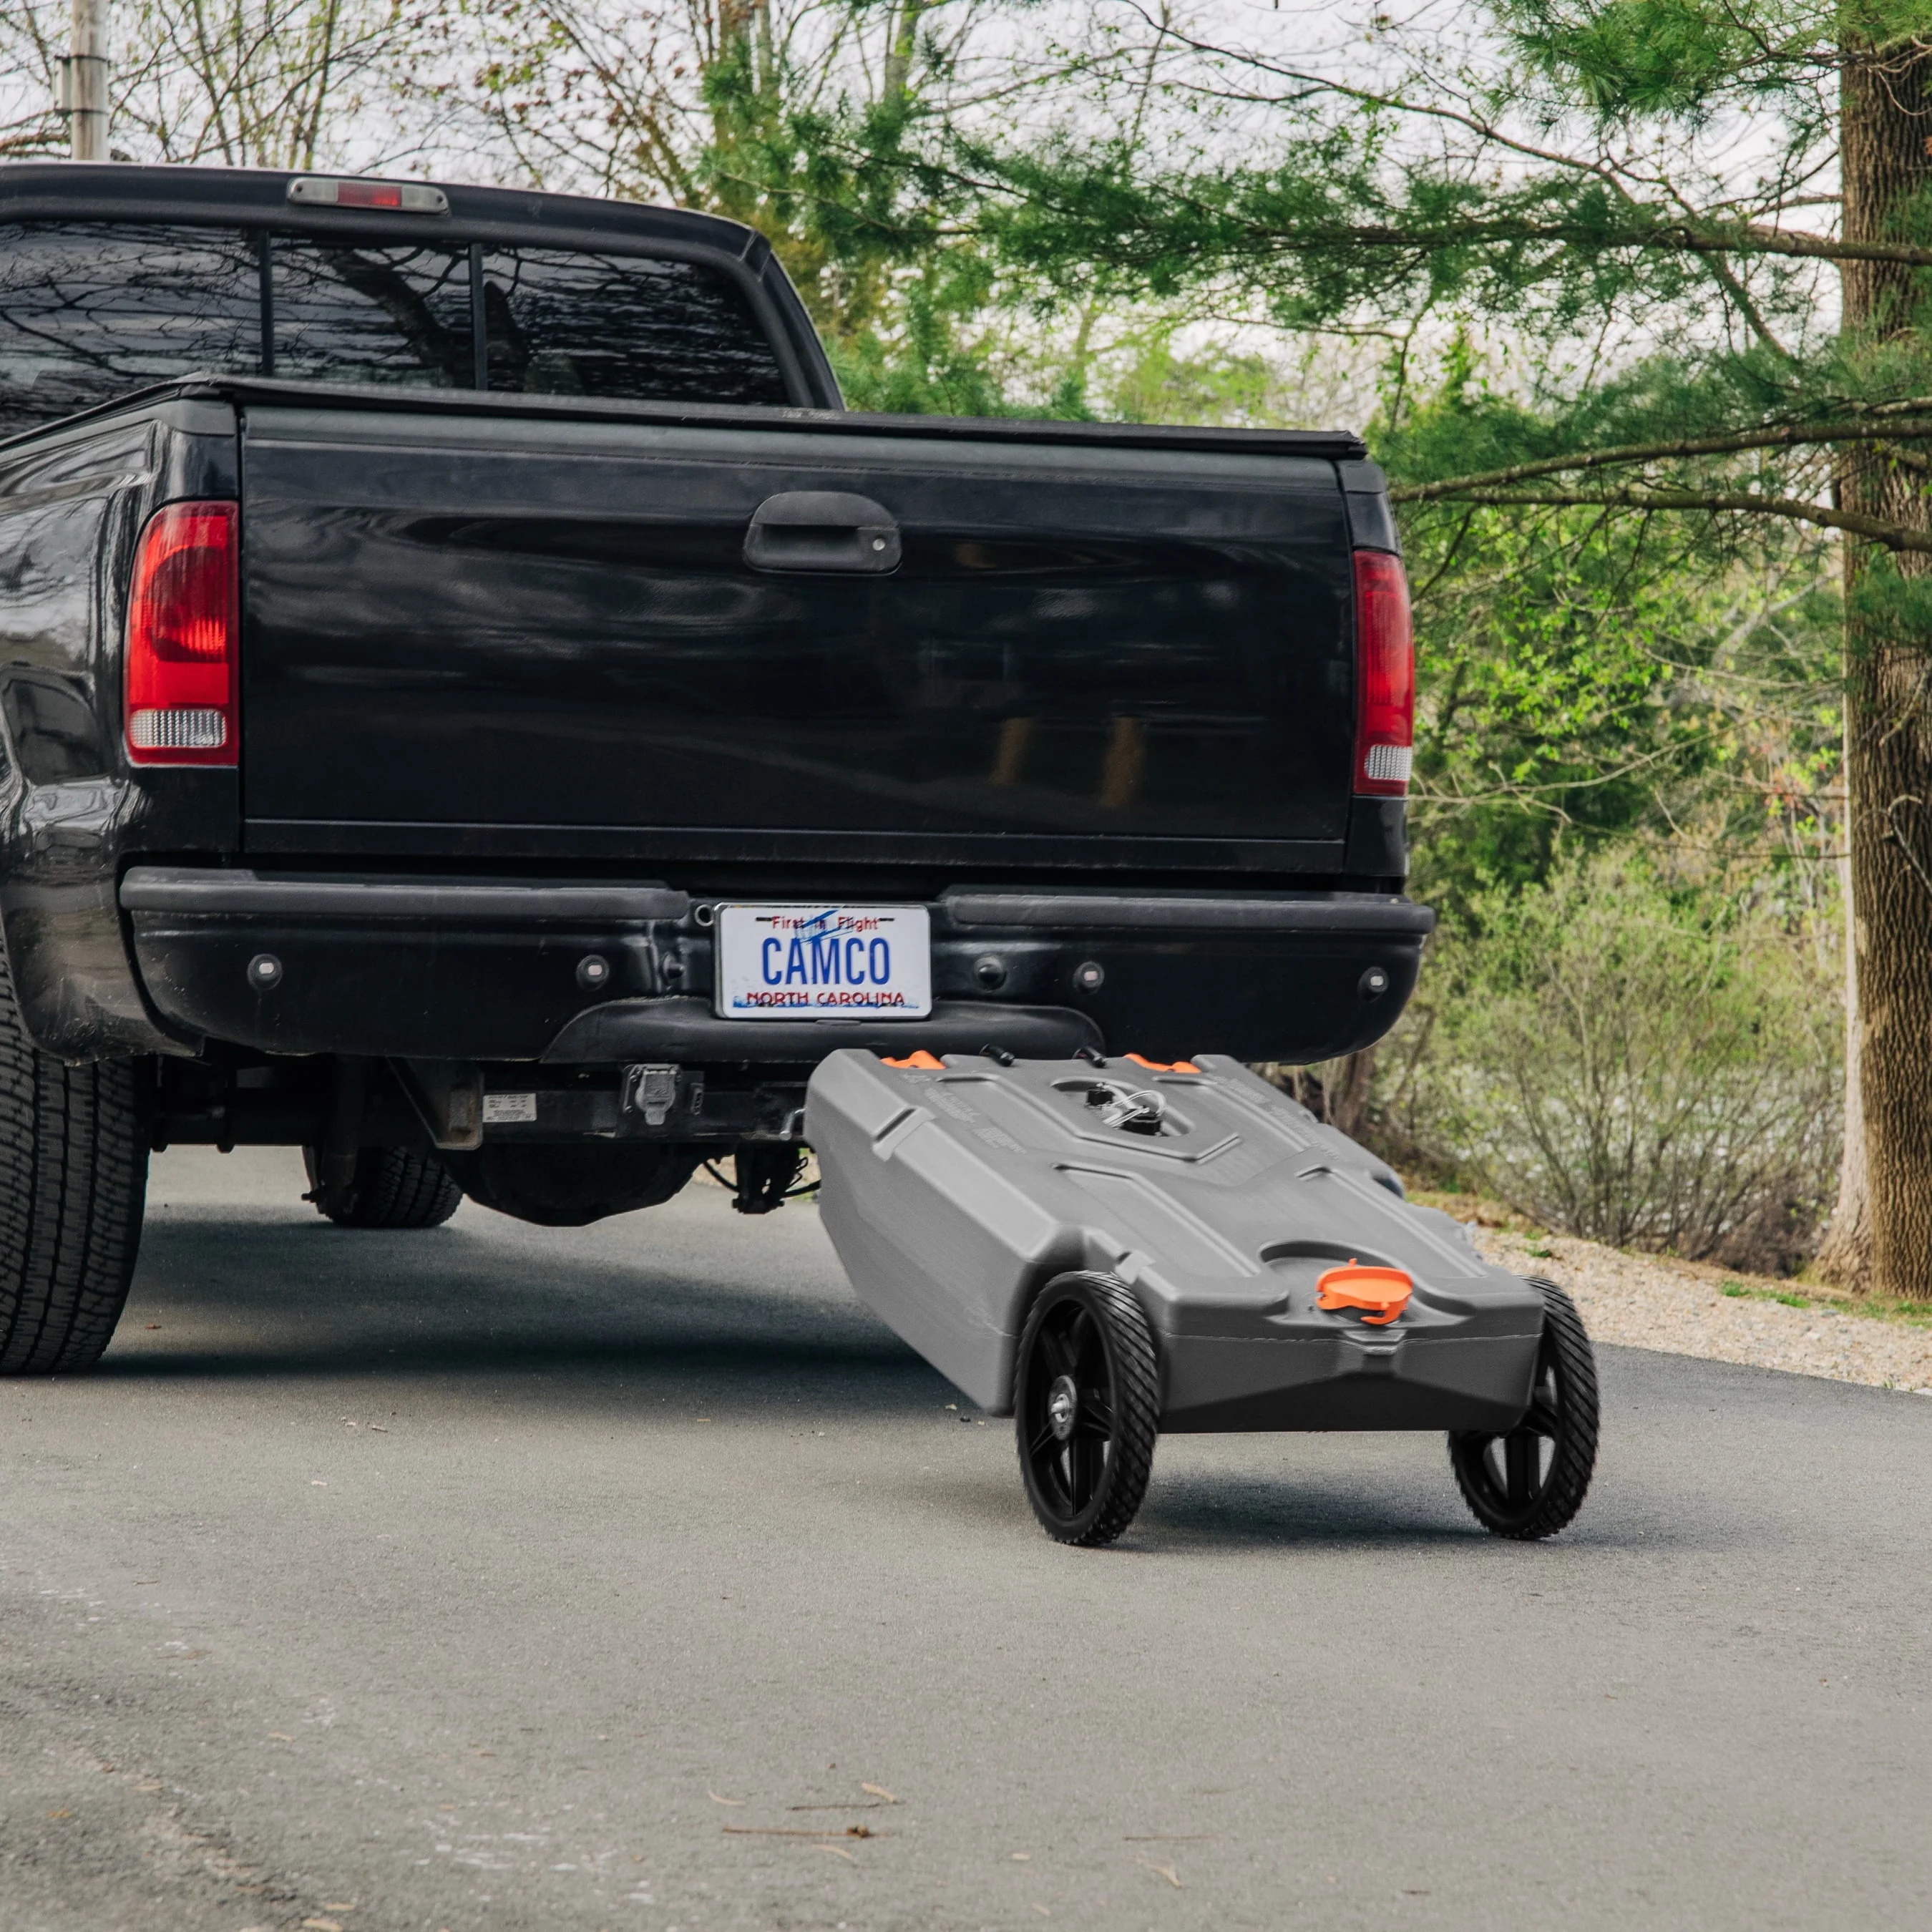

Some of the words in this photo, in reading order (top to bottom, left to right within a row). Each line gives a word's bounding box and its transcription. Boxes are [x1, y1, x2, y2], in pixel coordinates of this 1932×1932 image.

[772, 916, 804, 930] First
[838, 916, 879, 932] Flight
[762, 937, 891, 985] CAMCO
[746, 992, 809, 1005] NORTH
[817, 992, 905, 1006] CAROLINA
